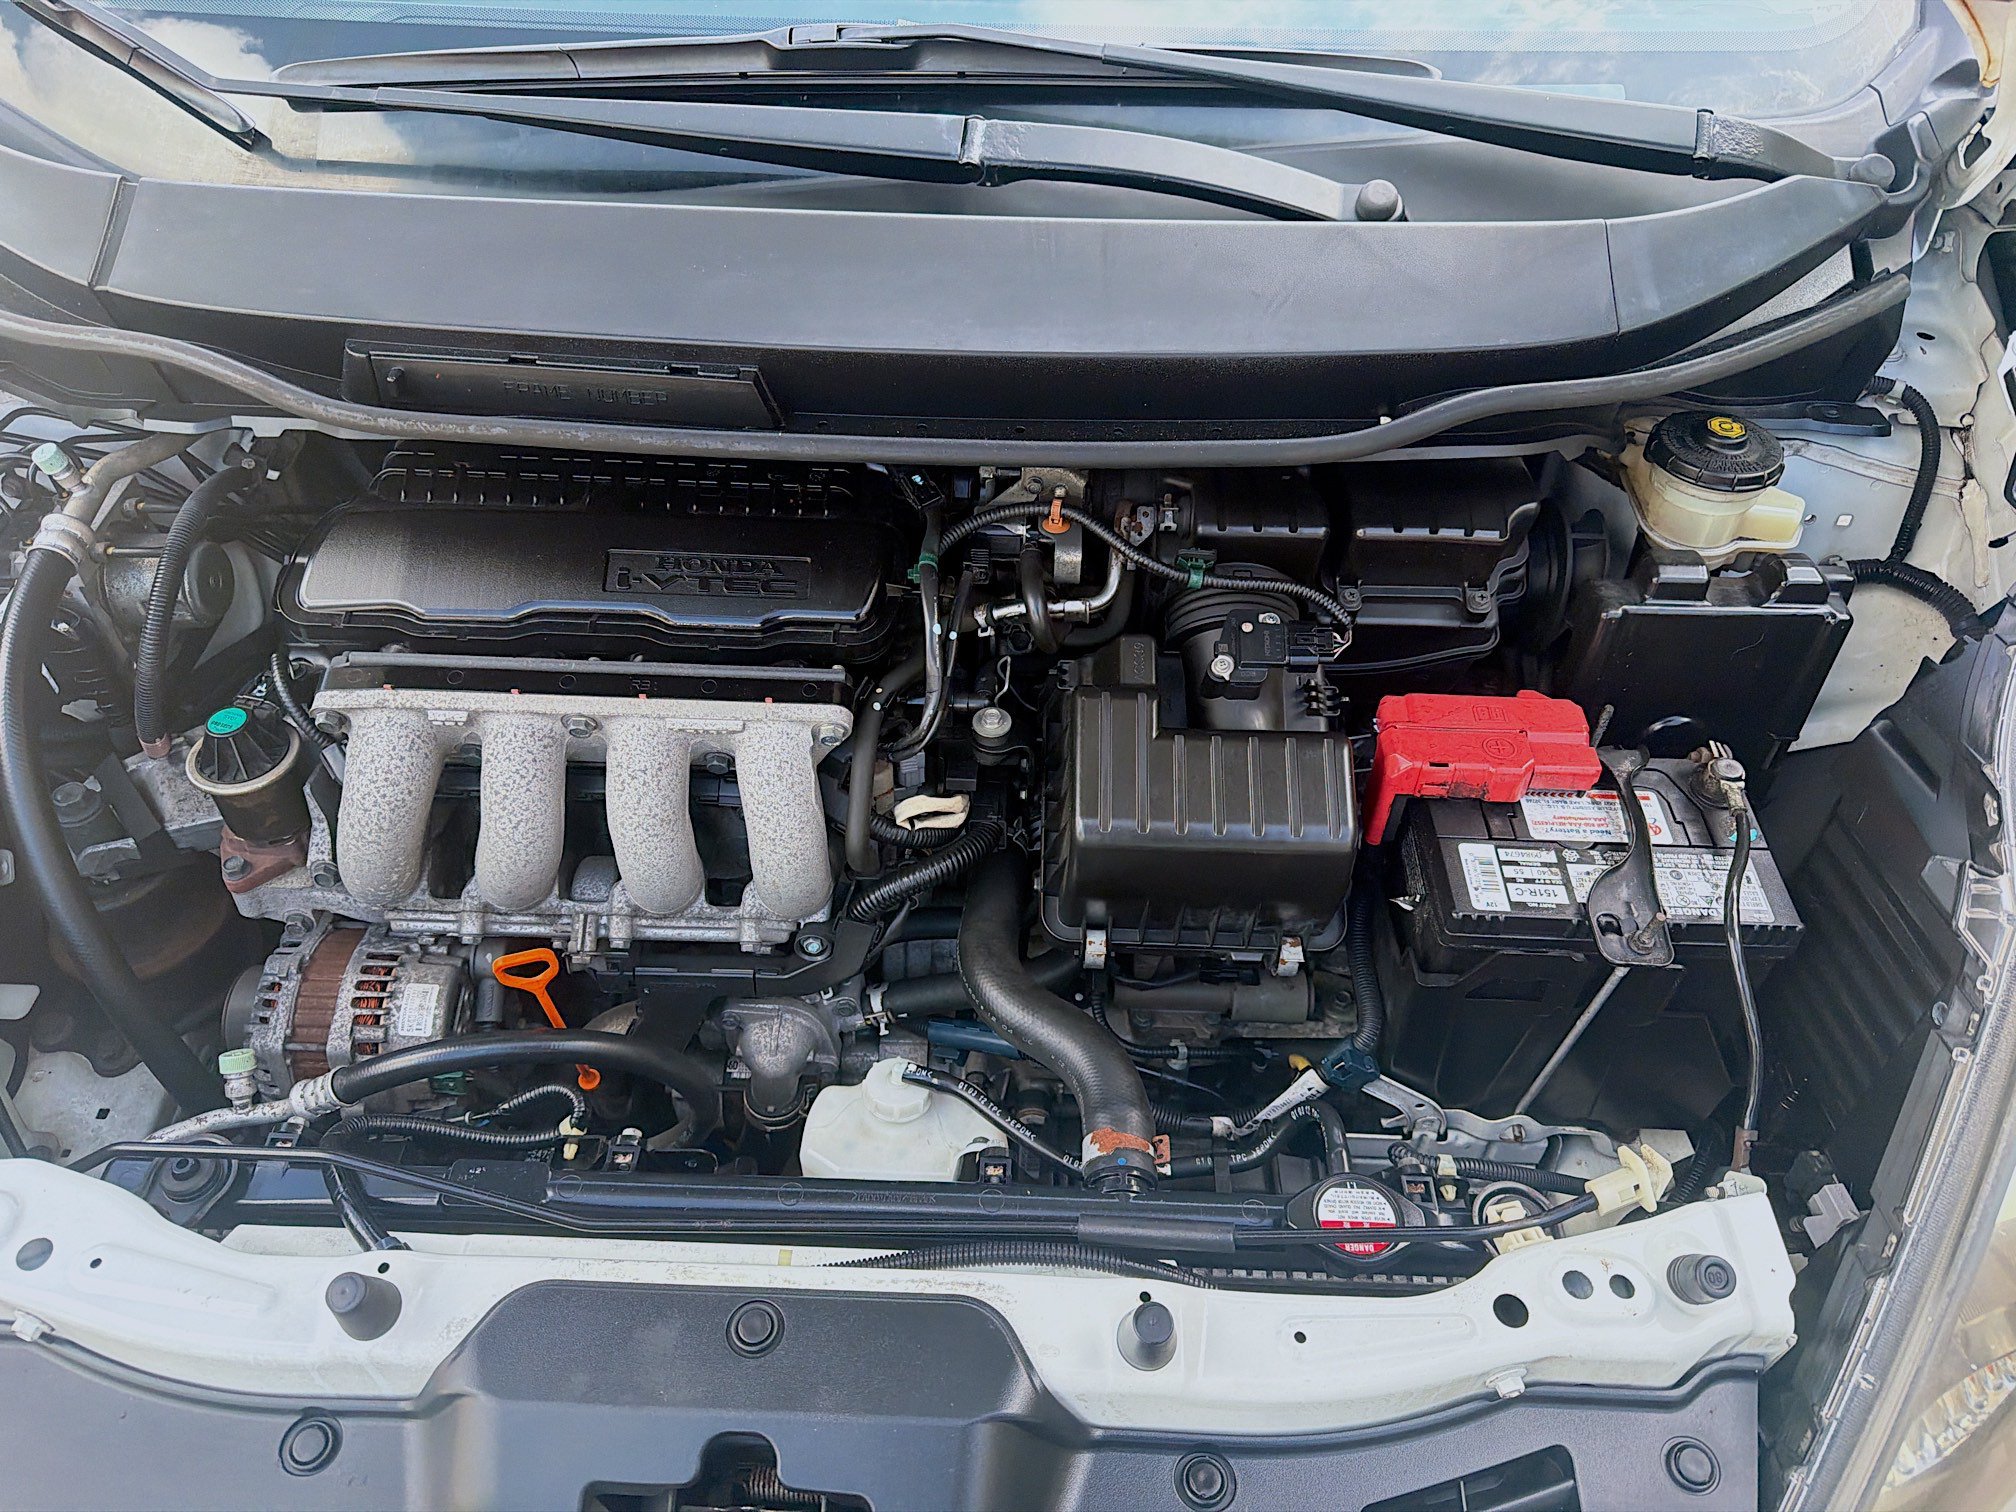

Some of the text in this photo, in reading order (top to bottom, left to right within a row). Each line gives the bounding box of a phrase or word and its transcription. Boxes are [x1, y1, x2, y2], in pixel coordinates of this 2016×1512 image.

[503, 380, 669, 406] FRAME NUMBER
[654, 556, 785, 577] HONDA
[615, 566, 798, 598] i-VTEC
[1545, 827, 1582, 836] Battery?
[1514, 887, 1558, 898] 151R-C
[1668, 907, 1719, 917] DANGER
[988, 1102, 1002, 1118] TPC
[1231, 1154, 1248, 1164] TPC
[1344, 1243, 1375, 1252] DANGER
